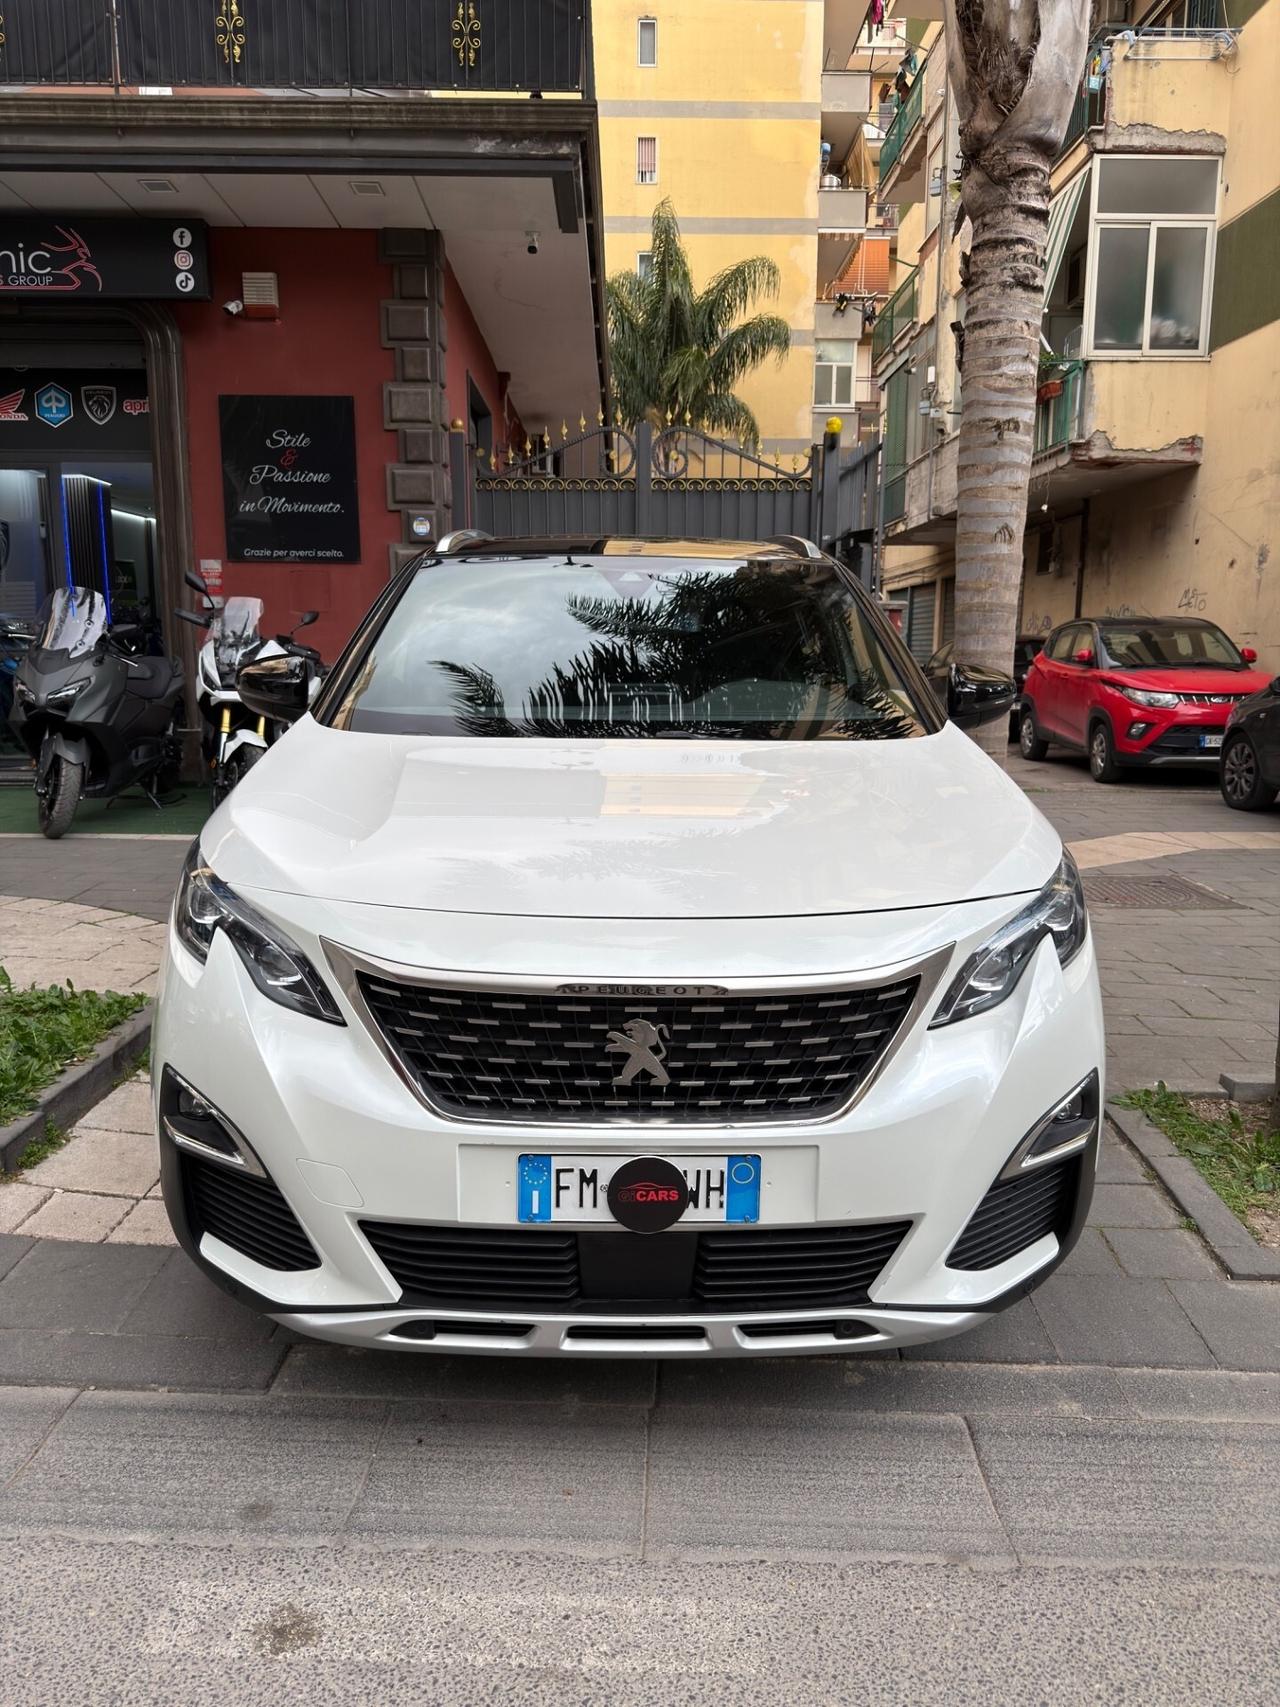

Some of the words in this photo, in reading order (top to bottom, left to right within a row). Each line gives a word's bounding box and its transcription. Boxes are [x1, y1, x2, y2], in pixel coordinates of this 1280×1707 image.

[8, 275, 53, 286] GROUP
[123, 397, 149, 415] apr
[266, 429, 312, 449] Stile
[249, 464, 331, 485] Passione
[240, 500, 256, 513] in
[257, 495, 344, 514] Movimento.
[243, 548, 272, 557] Grazie
[273, 549, 288, 558] per
[289, 548, 316, 558] averci
[578, 985, 705, 996] PEUGEOT
[556, 1168, 598, 1209] FM
